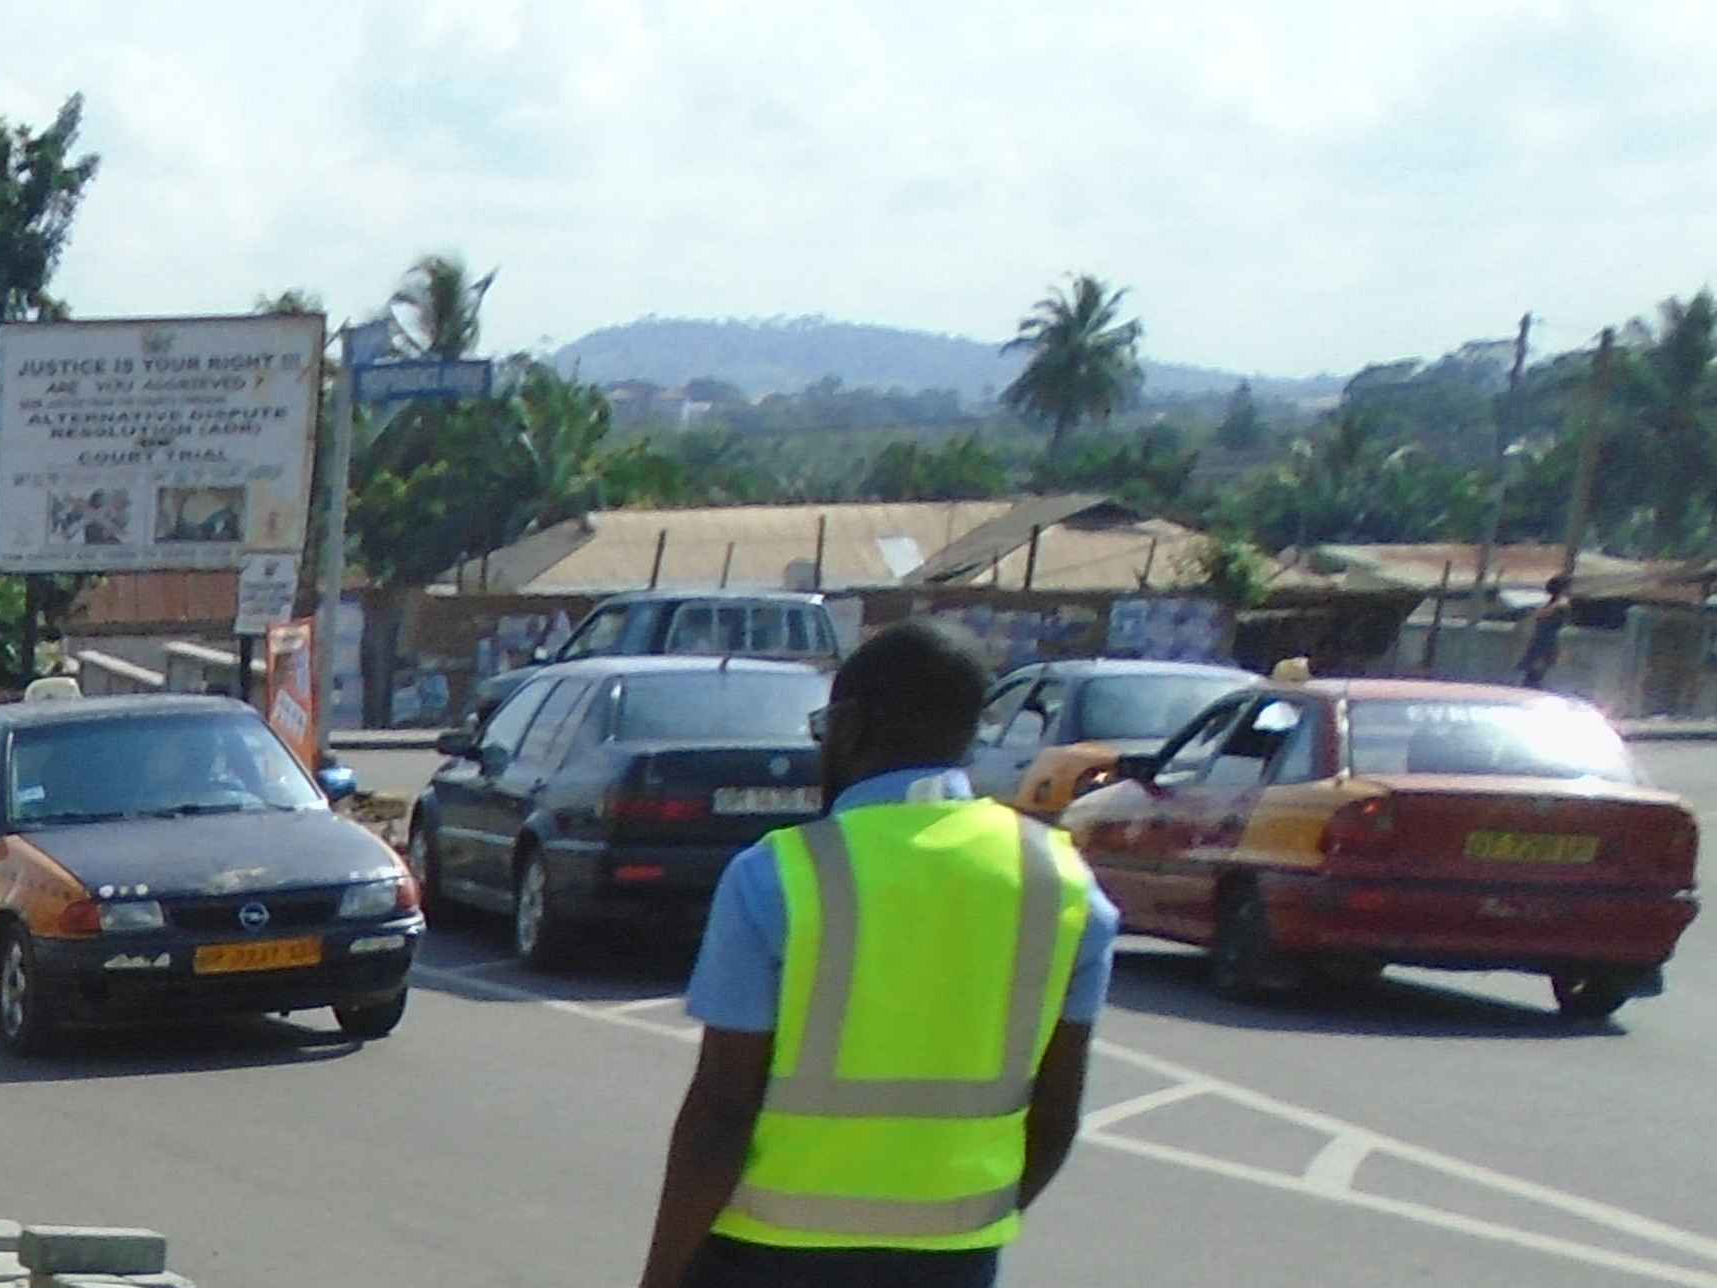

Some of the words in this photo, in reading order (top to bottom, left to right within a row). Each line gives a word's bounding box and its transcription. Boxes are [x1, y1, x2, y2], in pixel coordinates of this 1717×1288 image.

[18, 358, 105, 376] JUSTICE
[113, 358, 133, 374] IS
[142, 356, 200, 373] YOUR
[208, 353, 274, 371] RIGHT
[46, 380, 79, 394] ARE
[95, 379, 134, 393] YOU
[142, 376, 246, 391] AGGRIEVED
[27, 408, 180, 426] ALTERNATIVE
[189, 406, 288, 421] DISPUTE
[50, 424, 192, 439] RESOLUTION
[78, 449, 155, 465] COURT
[167, 447, 227, 463] TRIAL
